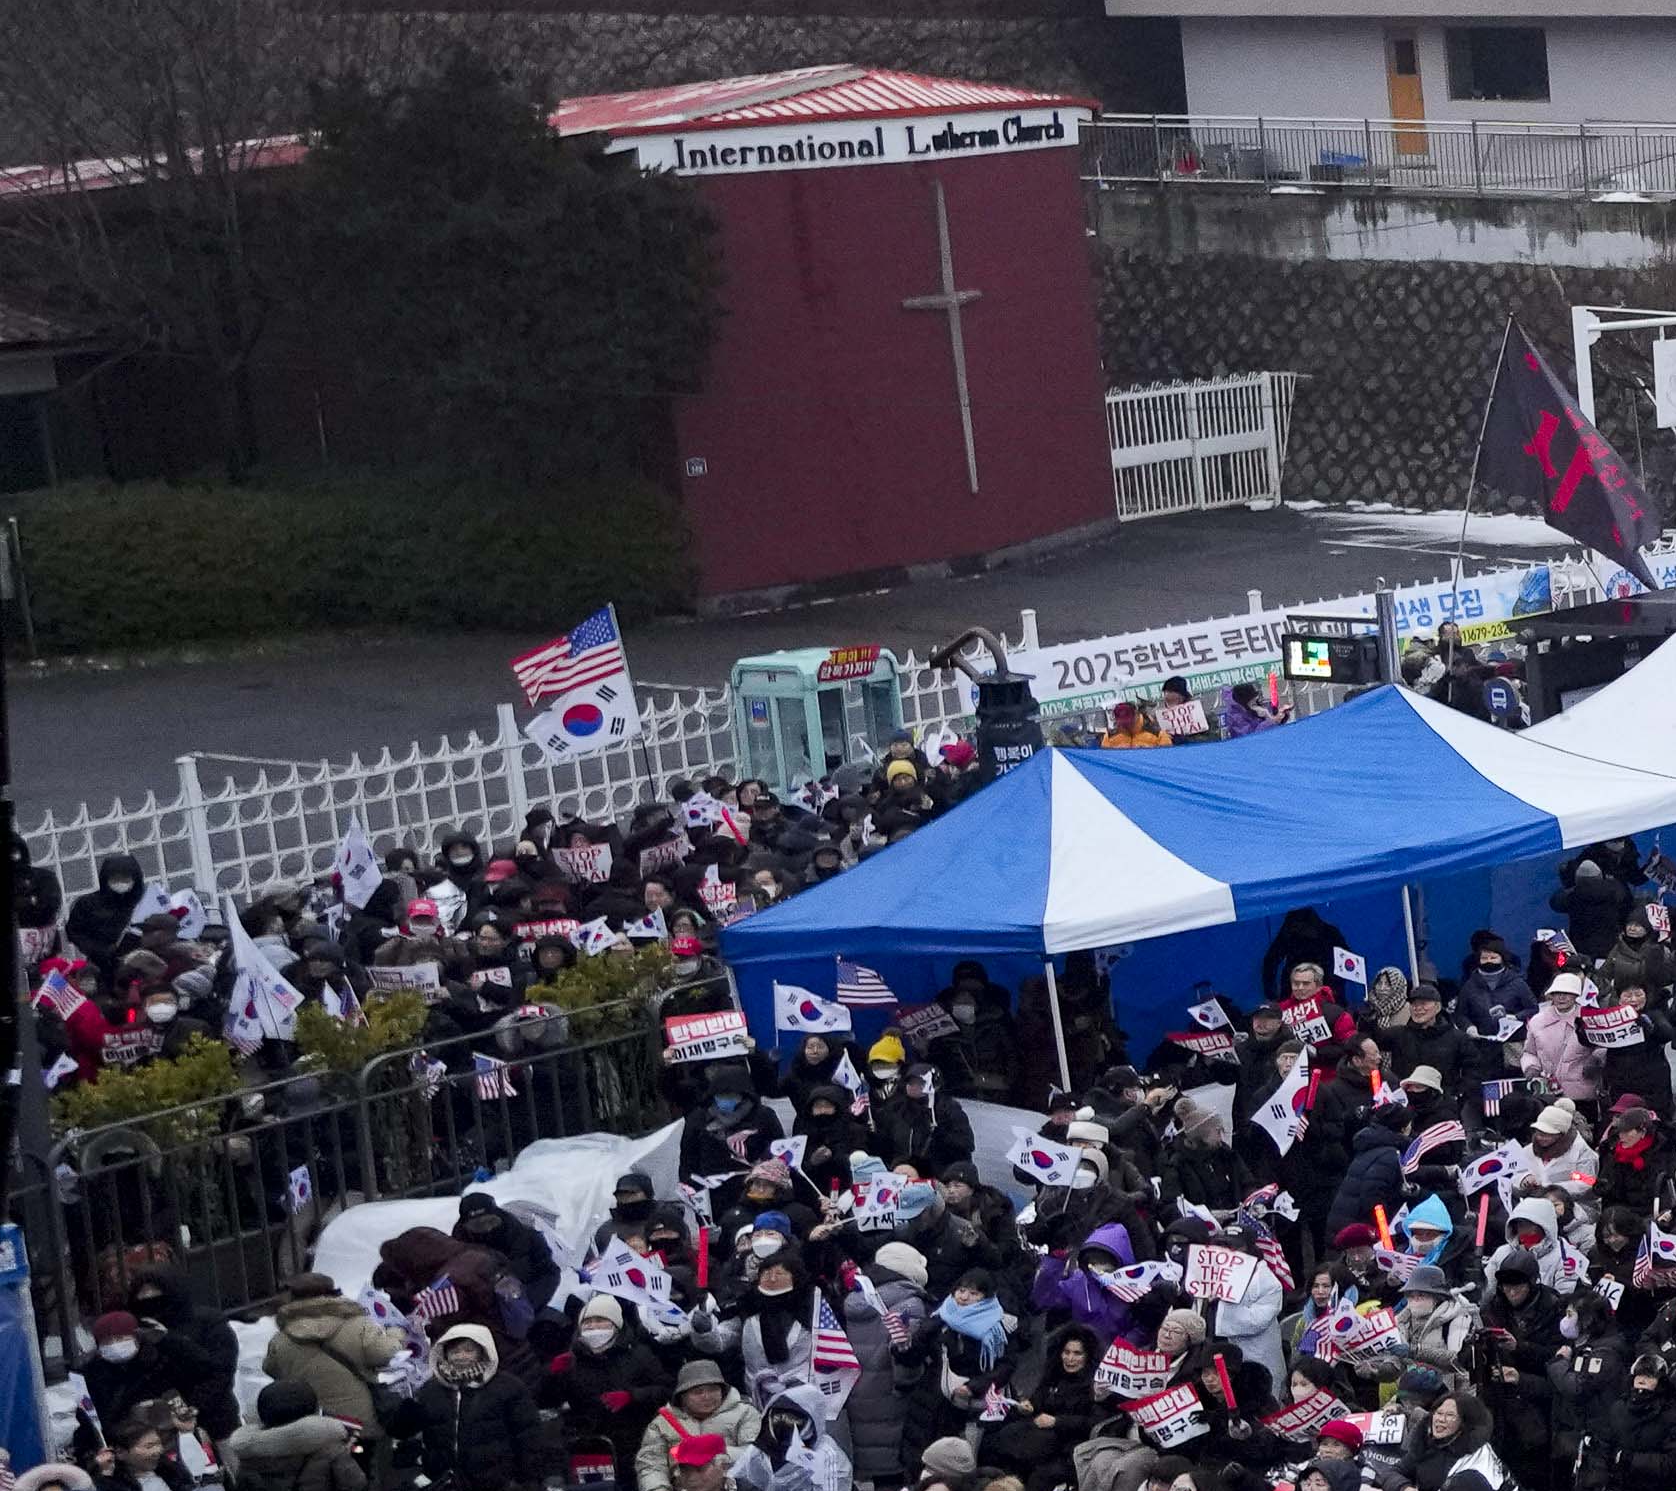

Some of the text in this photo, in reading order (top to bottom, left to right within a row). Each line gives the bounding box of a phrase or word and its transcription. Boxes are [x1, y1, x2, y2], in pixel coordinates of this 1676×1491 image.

[674, 111, 1066, 170] International Lutheran Church
[1053, 589, 1485, 690] 2025학년도 모집
[670, 1011, 744, 1042] 탄핵반대
[1282, 1001, 1319, 1024] 정선거
[671, 1032, 747, 1062] 이재명구속
[1196, 1248, 1244, 1268] STOP
[1200, 1267, 1232, 1281] THE
[1151, 1414, 1208, 1445] 명구속
